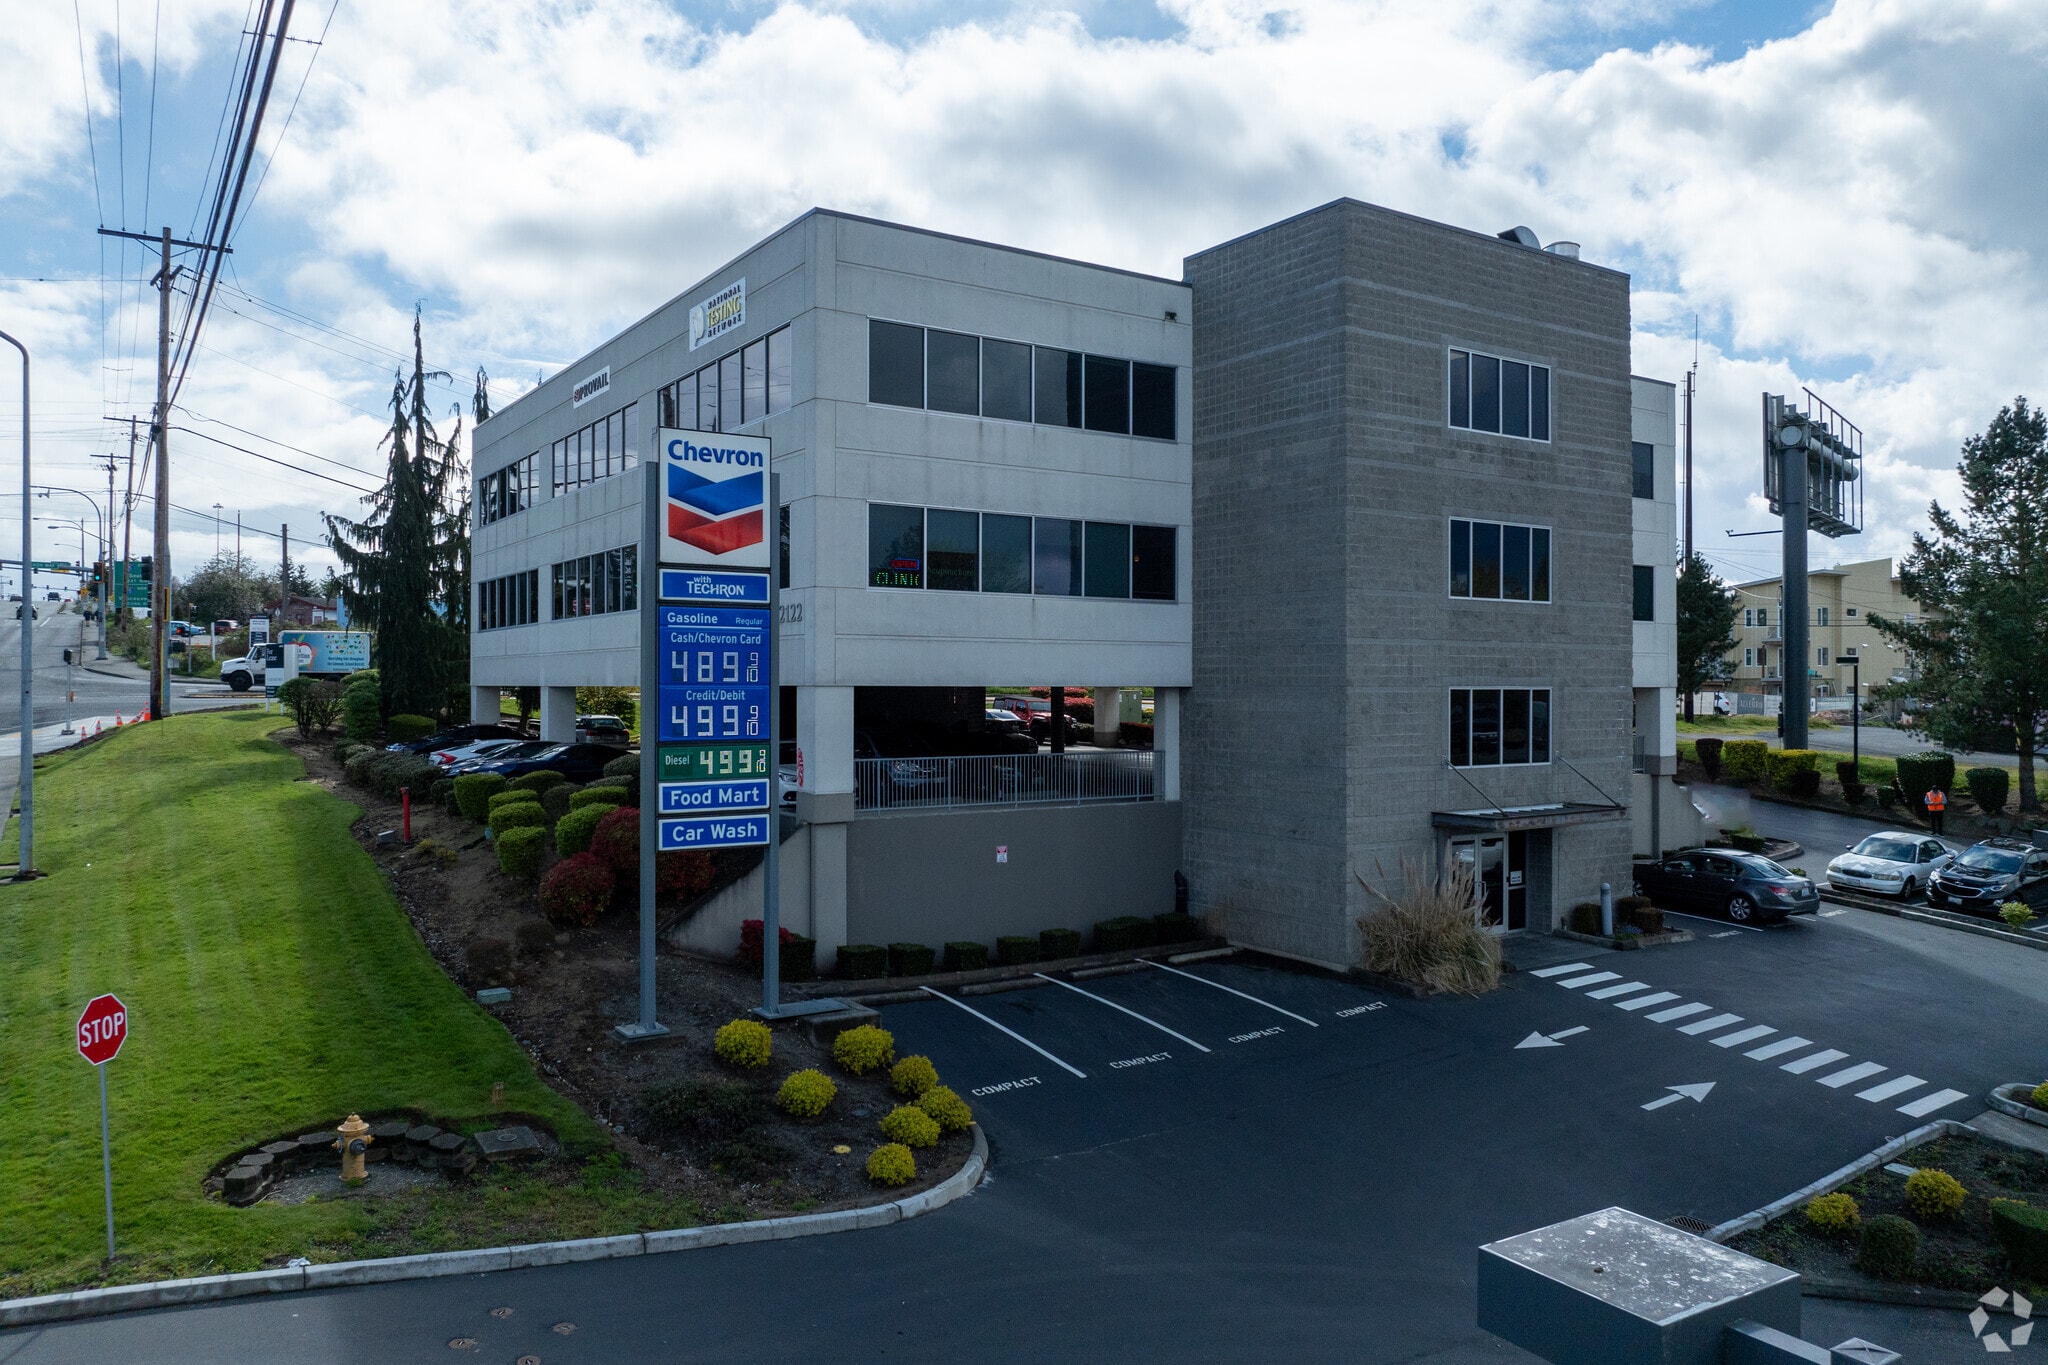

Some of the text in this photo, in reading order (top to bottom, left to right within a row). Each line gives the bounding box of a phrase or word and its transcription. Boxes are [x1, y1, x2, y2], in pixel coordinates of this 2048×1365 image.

[708, 284, 741, 309] NATIONAL
[706, 295, 742, 329] TESTING
[707, 313, 742, 338] NETWORK
[580, 372, 609, 401] PROVAIL
[668, 439, 763, 467] Chevron
[891, 559, 917, 569] OPEN
[693, 575, 712, 584] with
[686, 581, 745, 597] TECHRON
[667, 612, 763, 626] Gasoline Regular
[670, 632, 761, 645] Cash/Chevron Card
[686, 689, 746, 702] Credit/Debit
[665, 754, 690, 766] Diesel
[670, 788, 760, 806] Food Mart
[672, 824, 758, 842] Car Wash
[1335, 1001, 1389, 1019] COMPACT
[80, 1012, 125, 1047] STOP
[1228, 1026, 1286, 1044] COMPACT
[1109, 1051, 1172, 1071] COMPACT
[971, 1075, 1043, 1098] COMPACT
